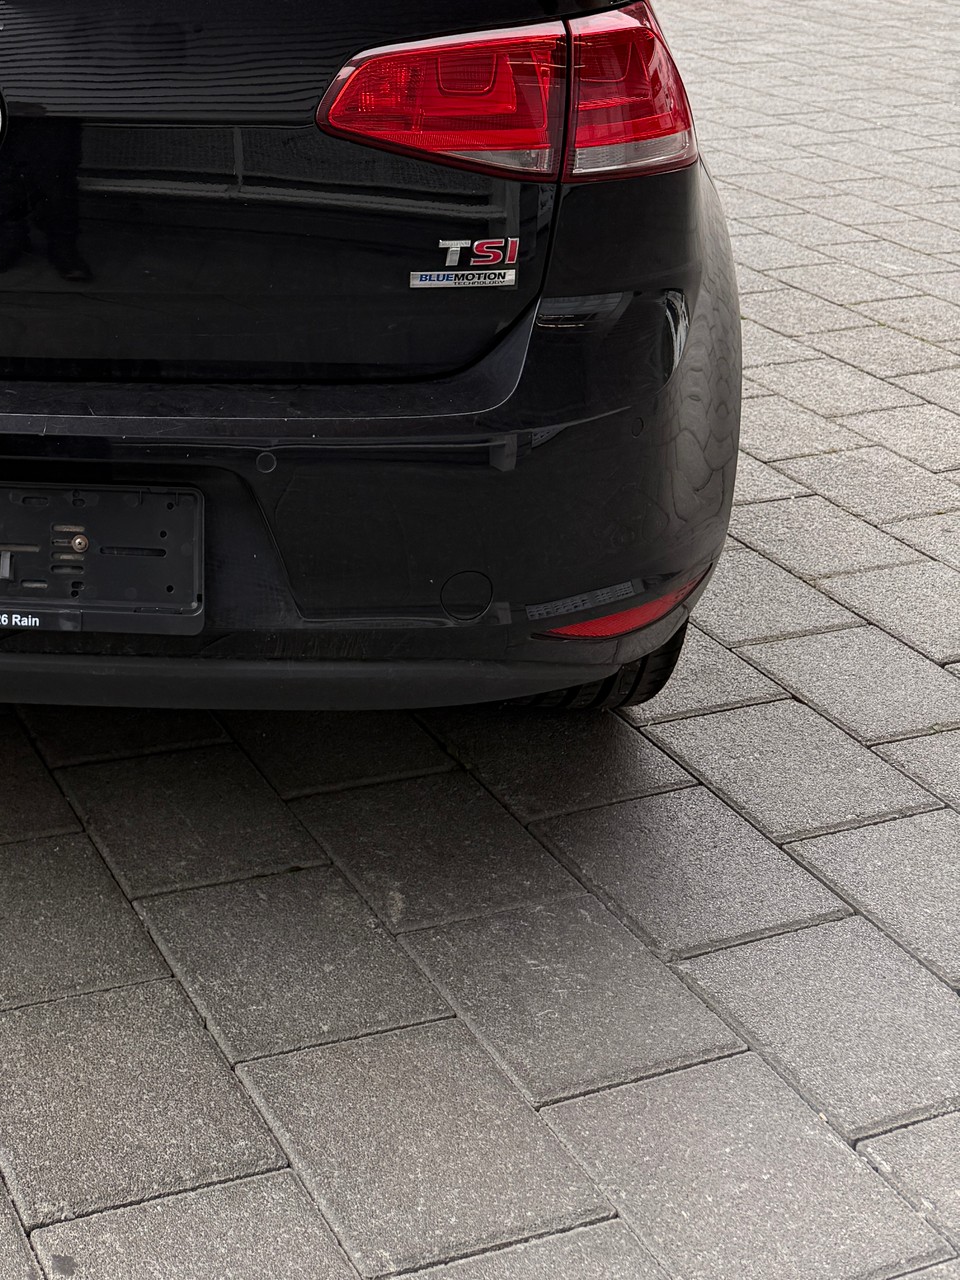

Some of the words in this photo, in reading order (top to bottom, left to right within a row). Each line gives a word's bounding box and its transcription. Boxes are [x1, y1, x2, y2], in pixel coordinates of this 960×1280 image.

[438, 237, 520, 267] TSI
[419, 272, 506, 282] BLUEMOTION
[11, 614, 40, 627] Rain
